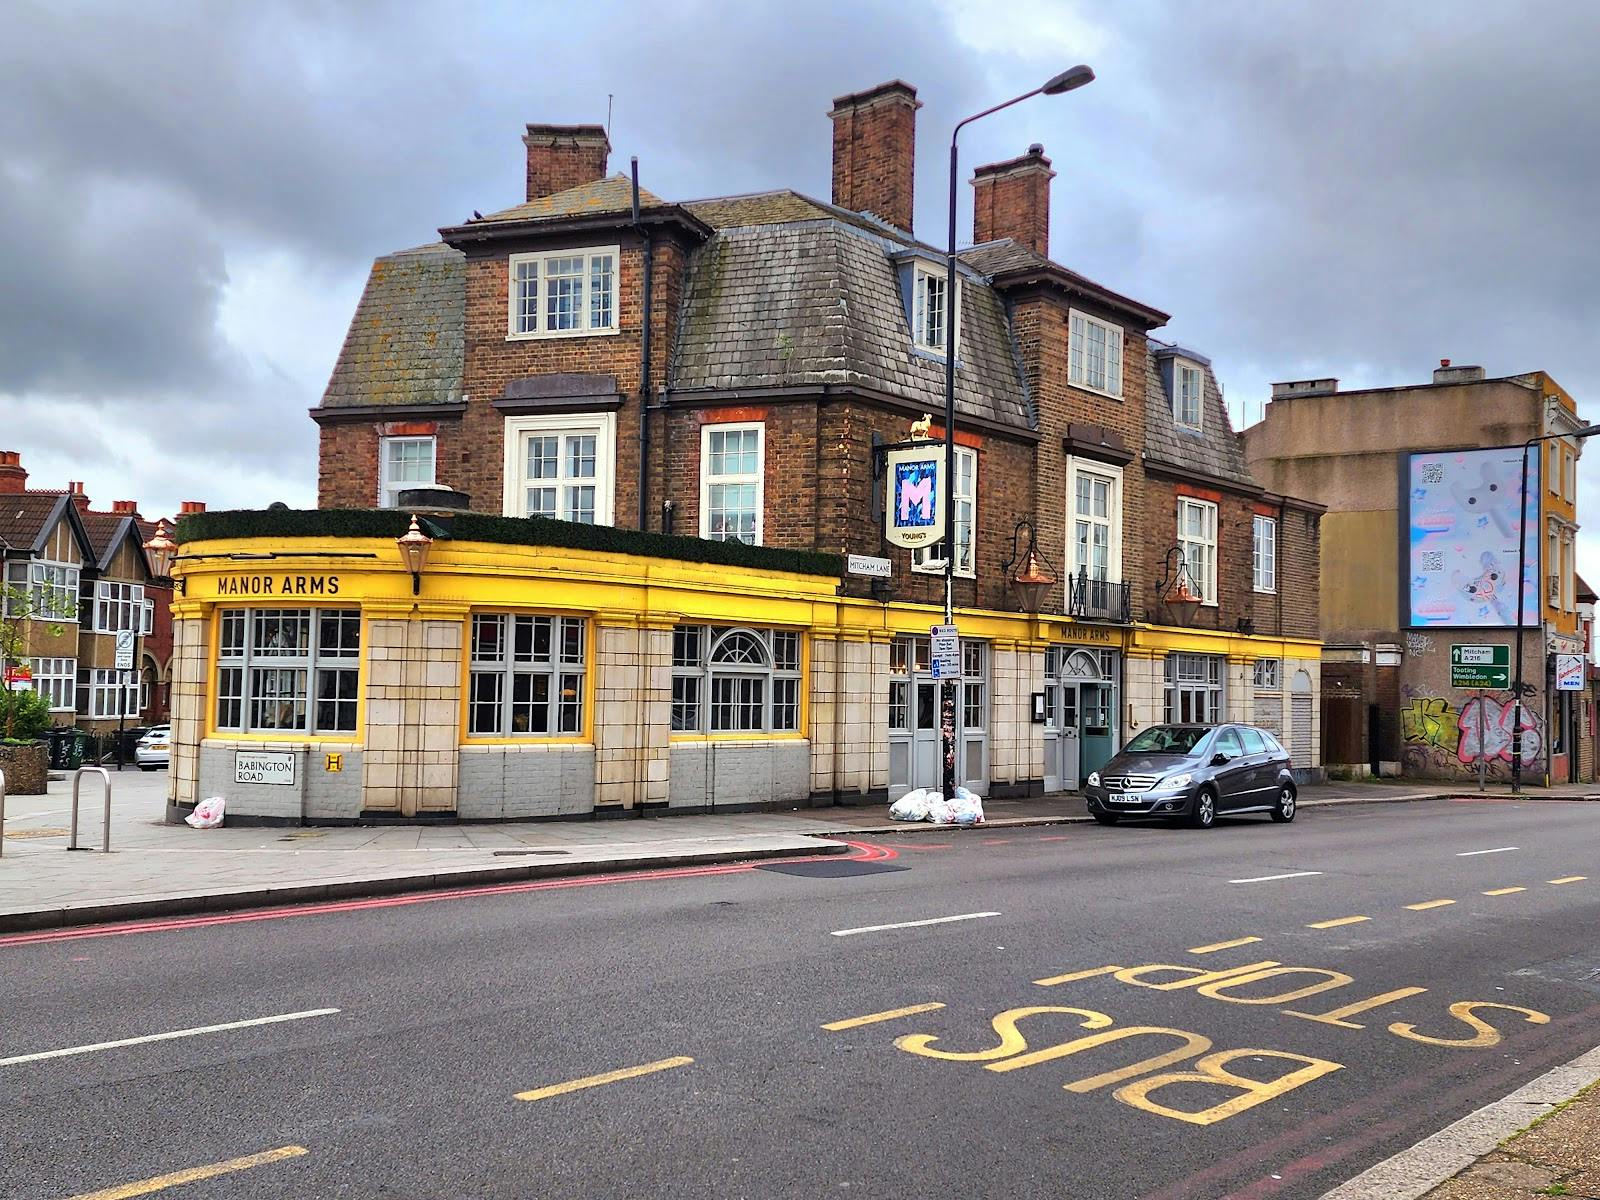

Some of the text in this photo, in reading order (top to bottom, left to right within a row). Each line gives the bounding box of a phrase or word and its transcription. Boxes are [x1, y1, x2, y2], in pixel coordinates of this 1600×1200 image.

[899, 463, 936, 472] MANOR ARMS
[901, 476, 932, 520] M
[850, 562, 890, 573] MITCHAM LANE
[217, 576, 339, 595] MANOR ARMS
[1061, 627, 1110, 641] MANOR ARMS
[238, 761, 292, 773] BABINGTON
[238, 771, 264, 782] ROAD
[1113, 960, 1551, 1048] STOP
[892, 1006, 1346, 1125] BUS
